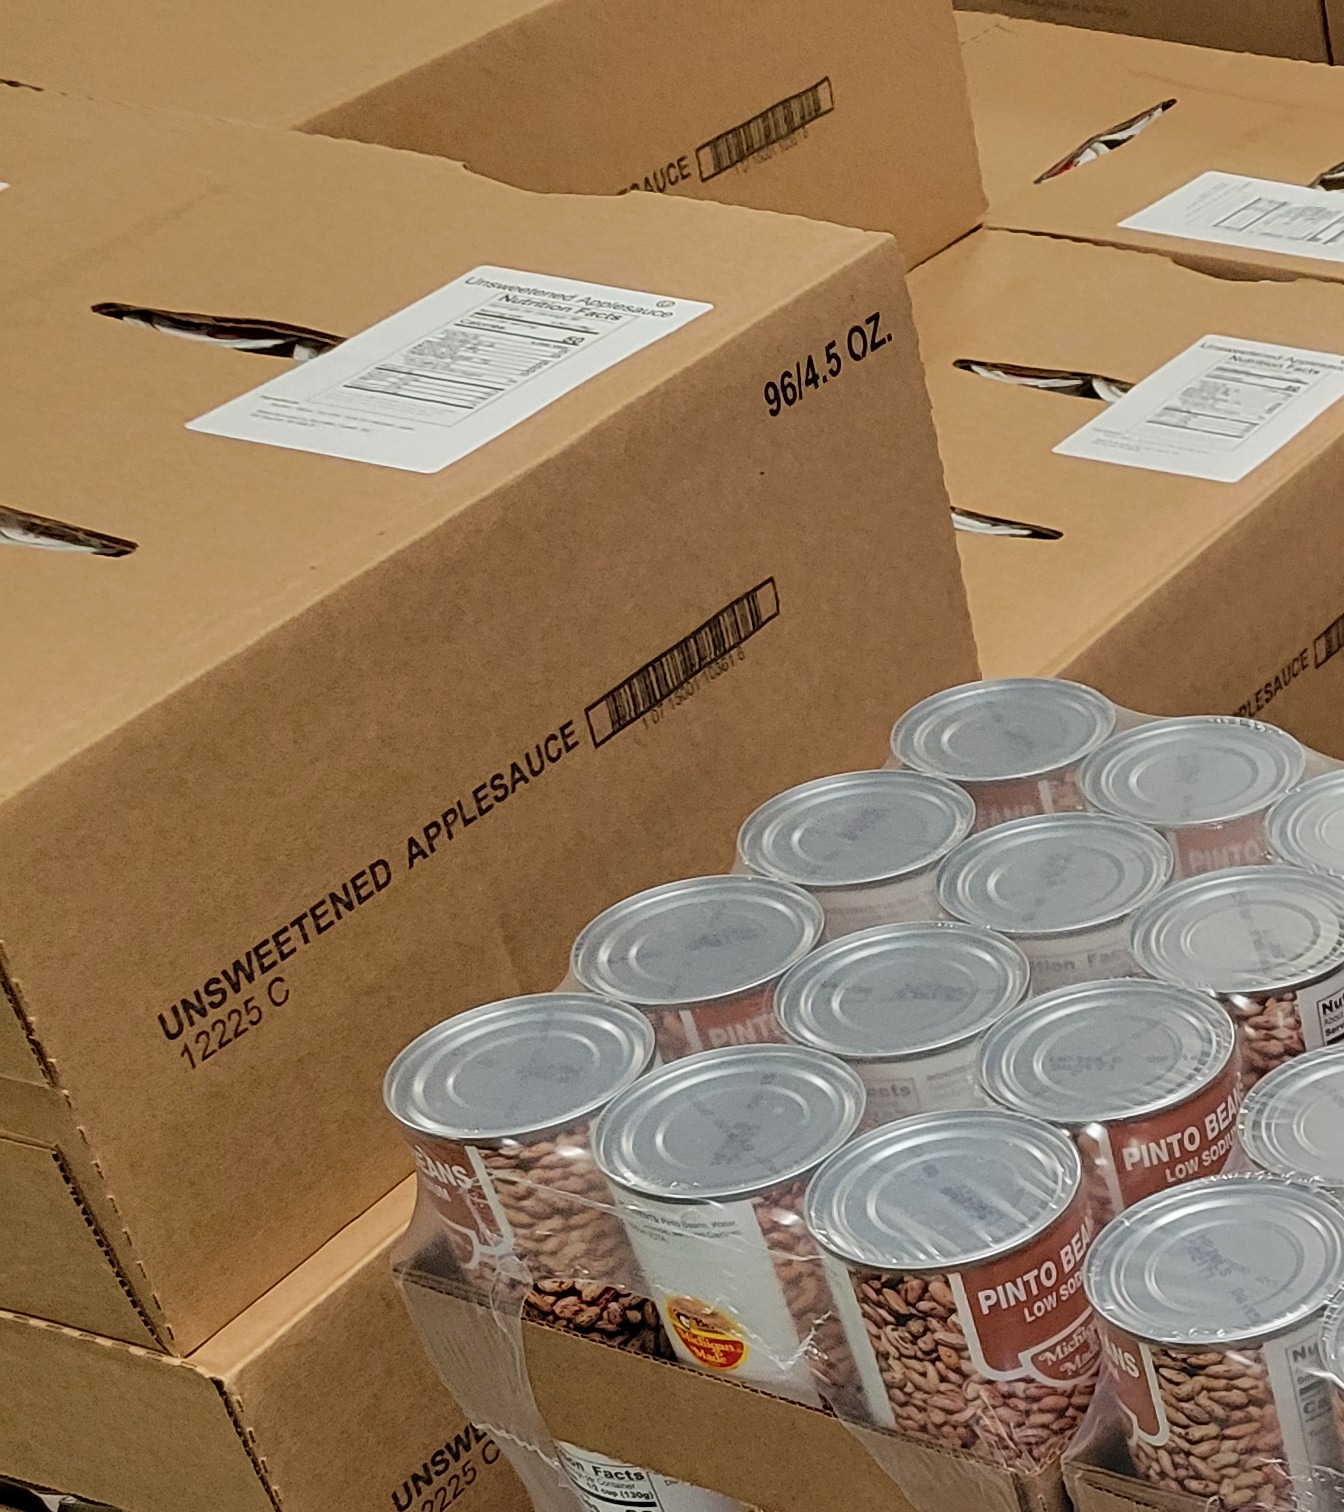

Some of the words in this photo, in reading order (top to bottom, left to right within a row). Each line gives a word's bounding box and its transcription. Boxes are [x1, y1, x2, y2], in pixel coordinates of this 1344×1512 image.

[465, 276, 578, 303] Unsweetened
[576, 296, 674, 318] Applesauce
[499, 294, 572, 313] Nutrition
[763, 340, 844, 418] 96/4.5
[846, 311, 895, 366] OZ.
[156, 856, 394, 1044] UNSWEETENED
[405, 720, 581, 869] APPLESAUCE
[180, 1000, 265, 1071] 12225
[266, 975, 291, 1008] C
[1122, 1126, 1201, 1171] PINTO
[1164, 1159, 1199, 1184] LOW
[976, 1261, 1057, 1315] PINTO
[1022, 1289, 1057, 1323] LOW
[592, 1464, 644, 1481] Facts
